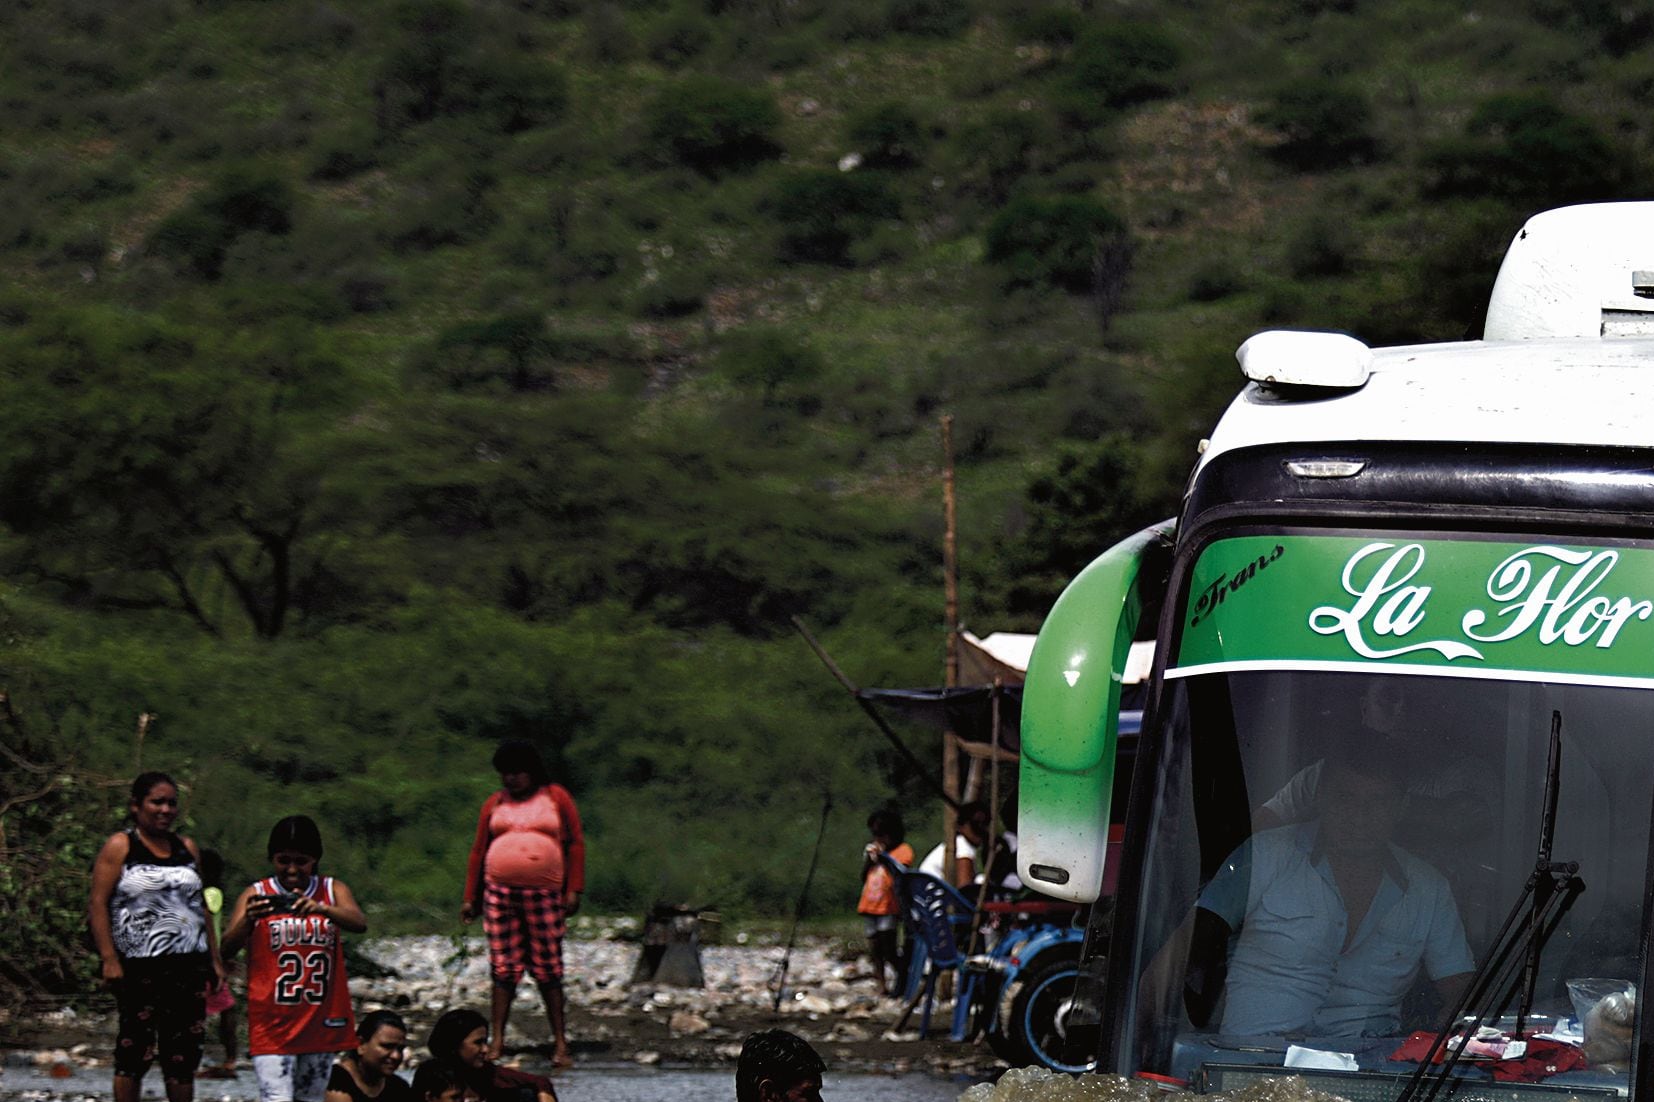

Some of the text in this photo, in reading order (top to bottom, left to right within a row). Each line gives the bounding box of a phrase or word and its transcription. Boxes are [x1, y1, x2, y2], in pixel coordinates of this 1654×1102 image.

[1190, 543, 1285, 628] Trans
[1308, 543, 1485, 661] La
[1462, 545, 1654, 649] Flor
[267, 916, 336, 952] BULLS
[274, 950, 332, 1006] 23
